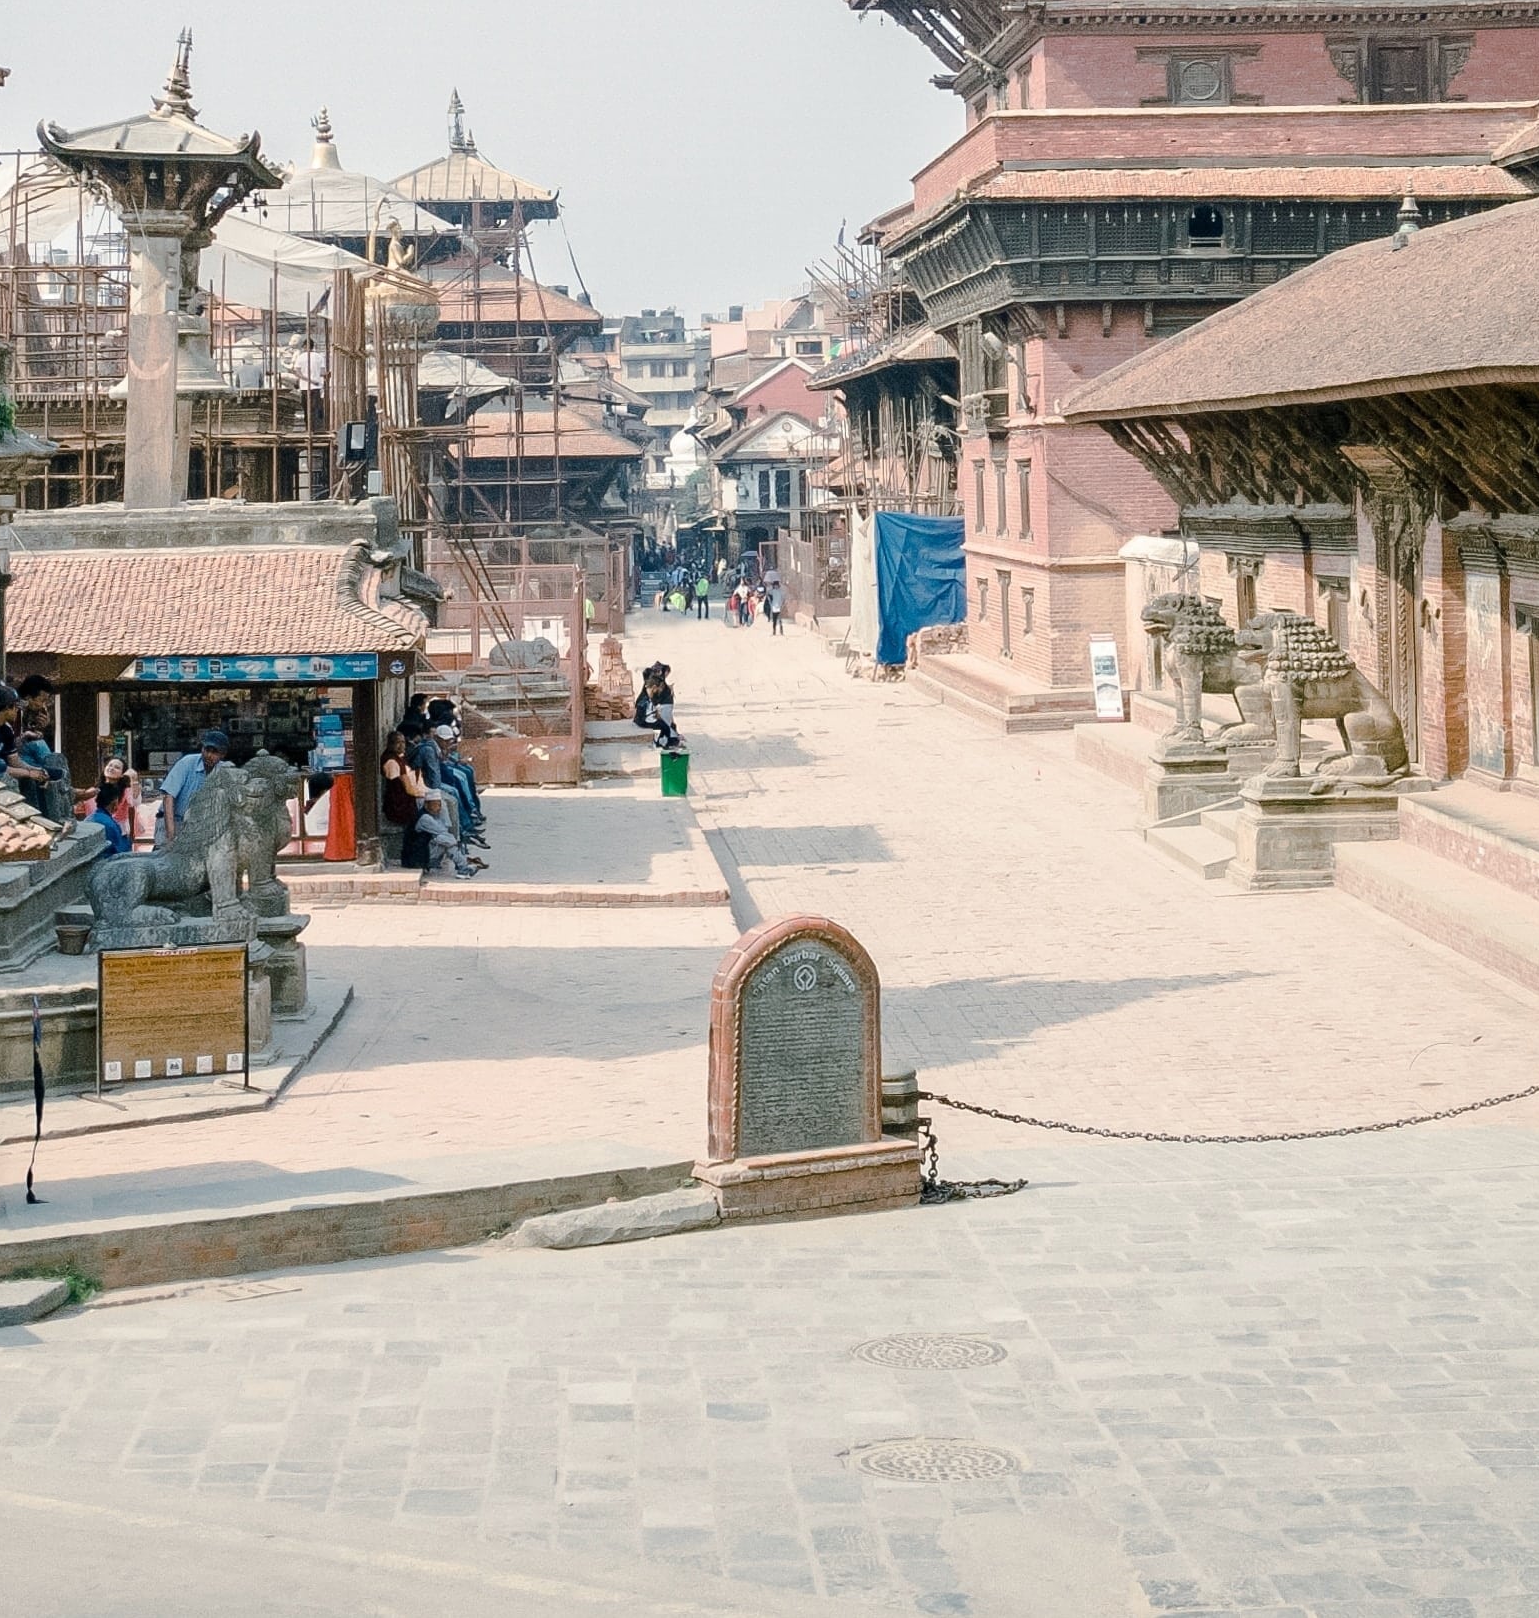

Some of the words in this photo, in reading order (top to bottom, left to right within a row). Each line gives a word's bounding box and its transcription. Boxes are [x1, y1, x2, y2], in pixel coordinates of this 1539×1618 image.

[752, 966, 781, 997] Patan
[782, 949, 822, 967] Durbar
[826, 957, 856, 993] Square
